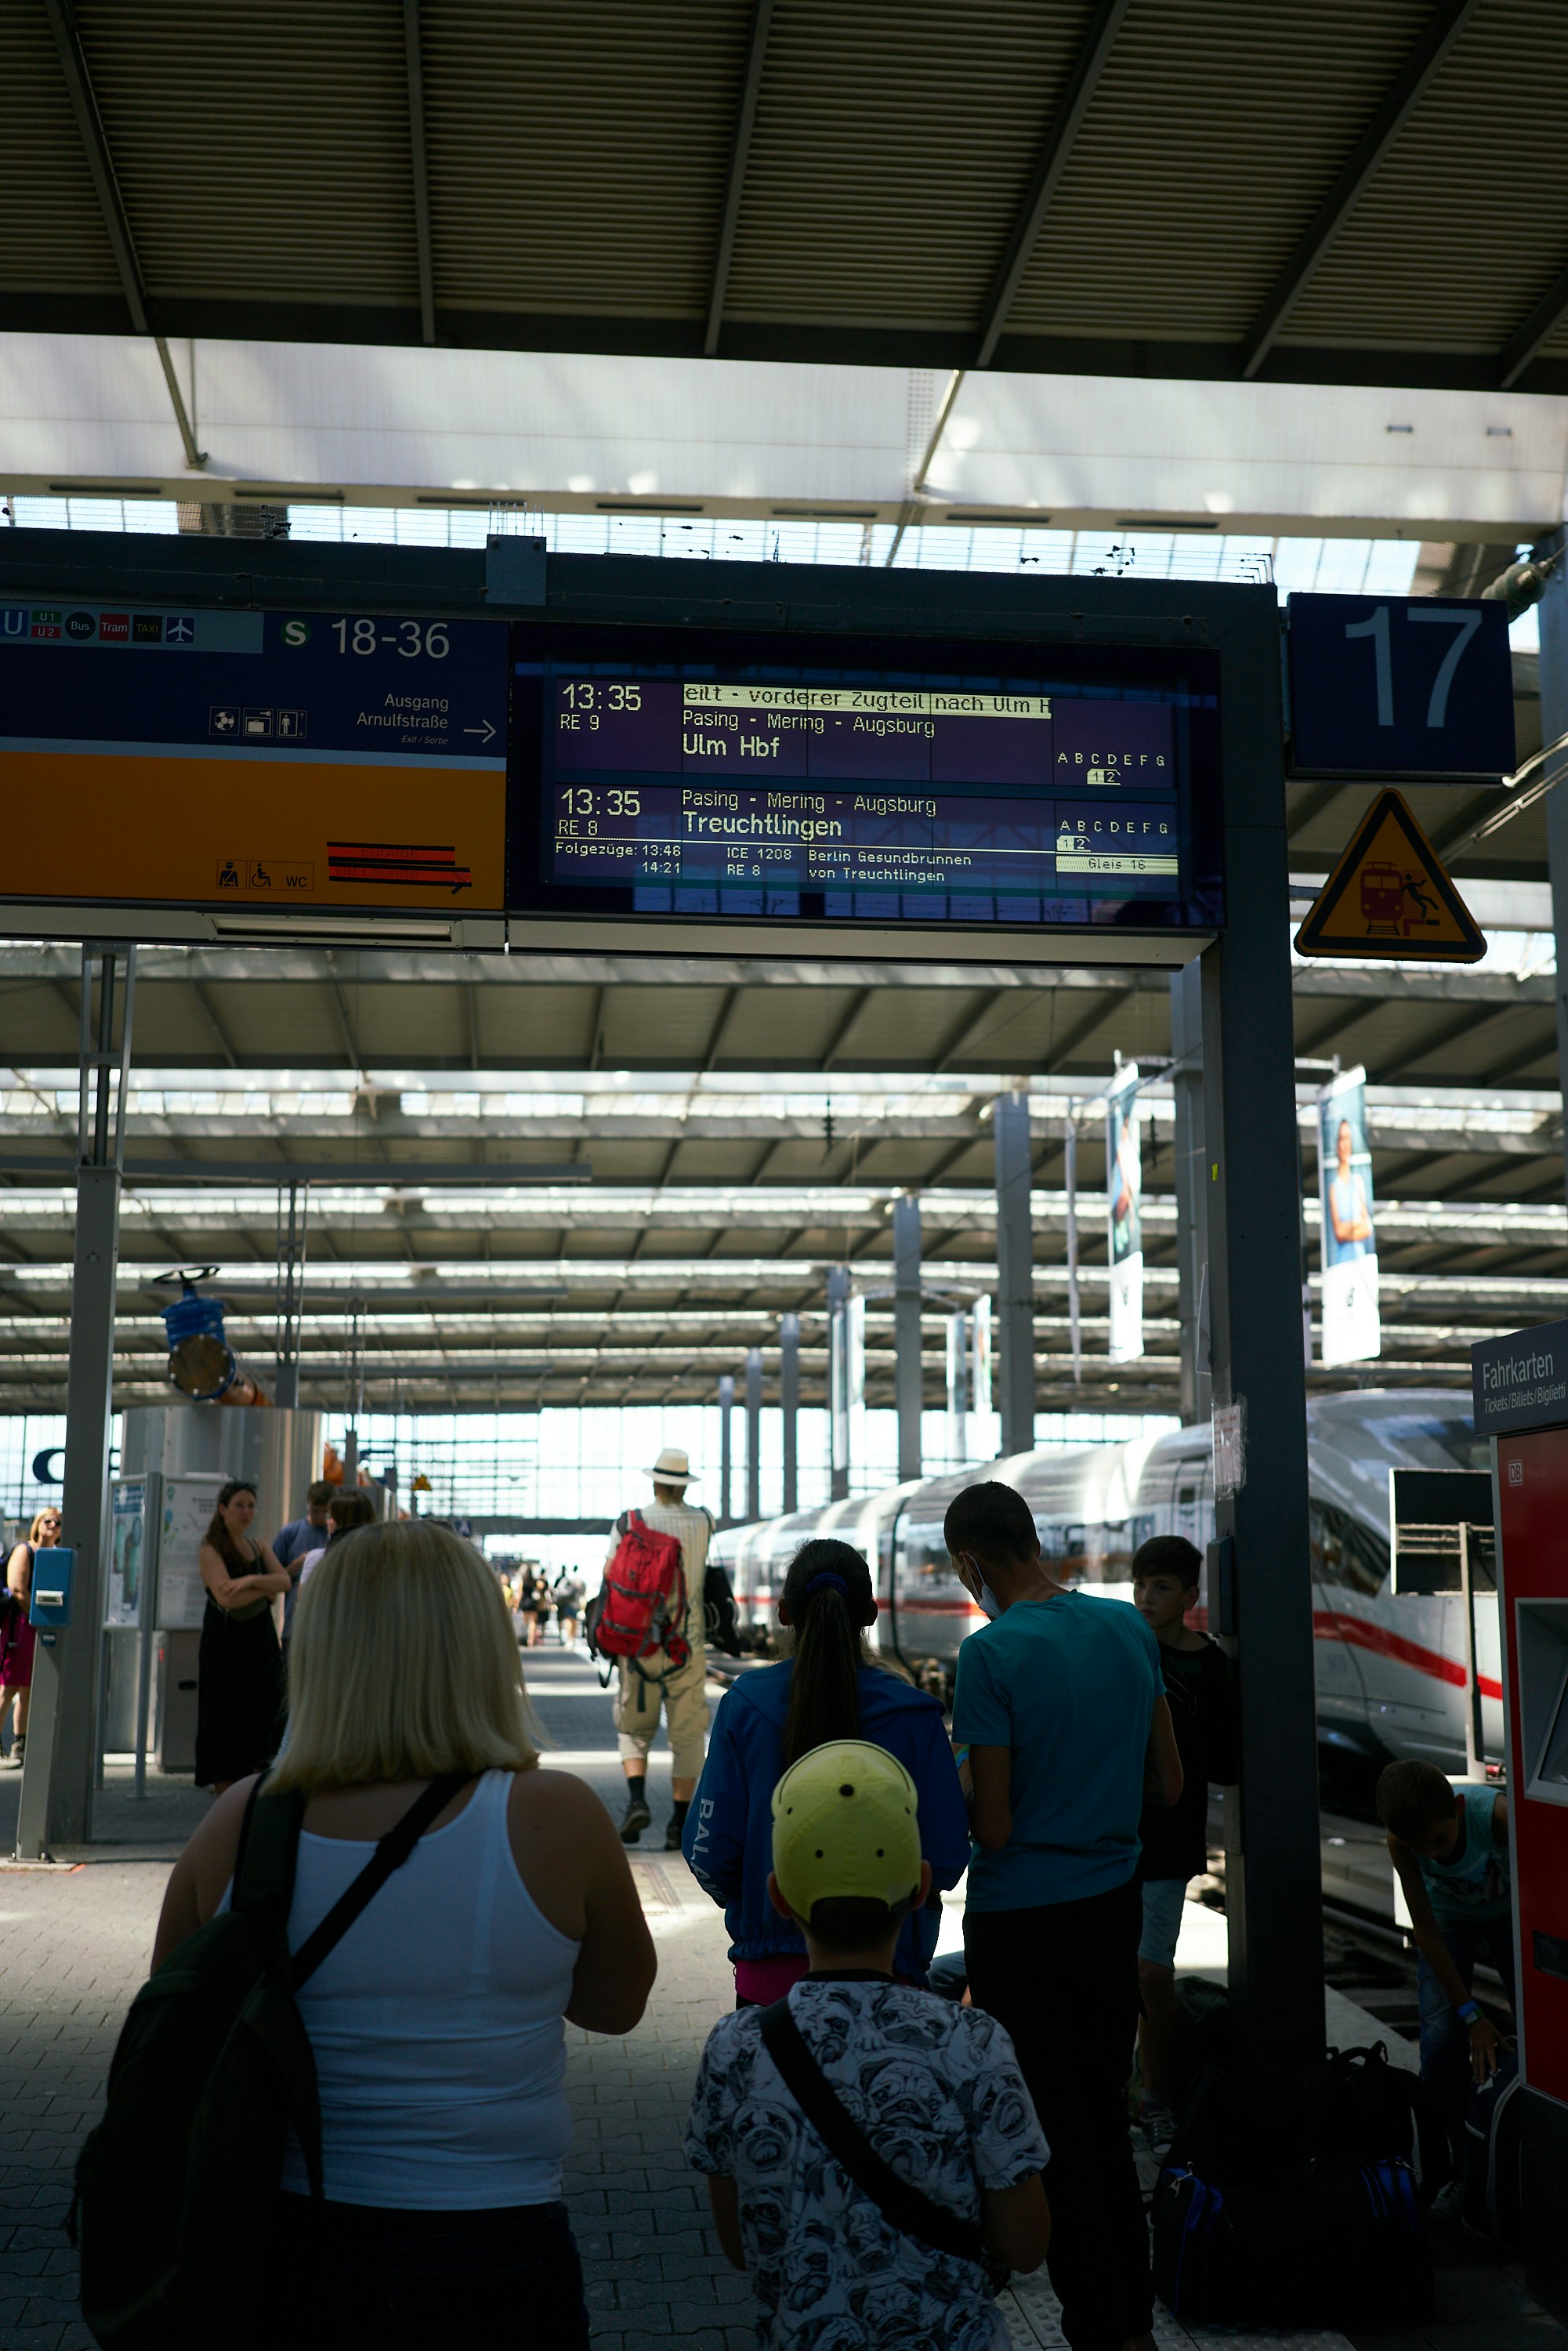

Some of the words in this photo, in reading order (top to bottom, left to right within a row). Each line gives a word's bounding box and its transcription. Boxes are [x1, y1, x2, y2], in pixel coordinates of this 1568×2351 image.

[5, 611, 23, 634] U
[71, 621, 89, 630] Bus
[102, 622, 127, 632] Tram
[136, 624, 158, 633] TAXI
[286, 619, 306, 645] S
[332, 618, 451, 658] 18-36
[1345, 606, 1482, 727] 17
[385, 694, 448, 712] Ausgang
[563, 684, 641, 710] 13:35
[686, 684, 722, 701] eilt
[750, 689, 842, 706] vorderer
[852, 691, 925, 711] Zugteil
[935, 697, 983, 712] nach
[994, 697, 1030, 713] Ulm
[357, 711, 447, 728] Arnulfstraße
[561, 714, 580, 729] RE
[590, 715, 599, 730] 9
[684, 710, 737, 730] Pasing
[768, 714, 824, 734] Mering
[853, 717, 935, 737] Augsburg
[424, 736, 448, 744] Sortie
[683, 734, 726, 755] Ulm
[741, 736, 779, 757] Hbf
[1058, 752, 1067, 763] A
[1075, 753, 1082, 763] B
[1092, 754, 1099, 763] C
[1108, 754, 1117, 764] D
[1124, 755, 1132, 765] E
[1141, 755, 1147, 765] F
[1157, 756, 1164, 766] G
[1107, 772, 1114, 782] 2
[561, 789, 639, 816] 13:35
[683, 790, 737, 810] Pasing
[768, 793, 824, 813] Mering
[854, 795, 936, 817] Augsburg
[559, 820, 578, 835] RE
[588, 820, 597, 835] 8
[683, 812, 842, 841] Treuchtlingen
[1060, 820, 1070, 831] A
[1078, 820, 1085, 831] B
[1095, 821, 1102, 831] C
[1111, 822, 1119, 832] D
[1127, 822, 1135, 832] E
[1143, 823, 1150, 833] F
[1160, 824, 1167, 833] G
[556, 842, 637, 857] Folgezüge:
[643, 845, 680, 856] 13:46
[728, 847, 748, 858] ICE
[758, 849, 791, 860] 1208
[809, 849, 851, 862] Berlin
[858, 851, 972, 866] Gesundbrunnen
[1076, 839, 1085, 849] 2
[643, 862, 679, 873] 14:21
[728, 864, 744, 875] RE
[752, 865, 760, 875] 8
[843, 867, 945, 883] Treuchtlingen
[1088, 857, 1123, 871] Gleis
[1130, 859, 1146, 870] 16
[285, 875, 307, 887] WC
[1483, 1353, 1554, 1390] Fahrkarten
[1484, 1382, 1566, 1413] Tickets/Billets/Biglietti
[1508, 1462, 1522, 1483] DB
